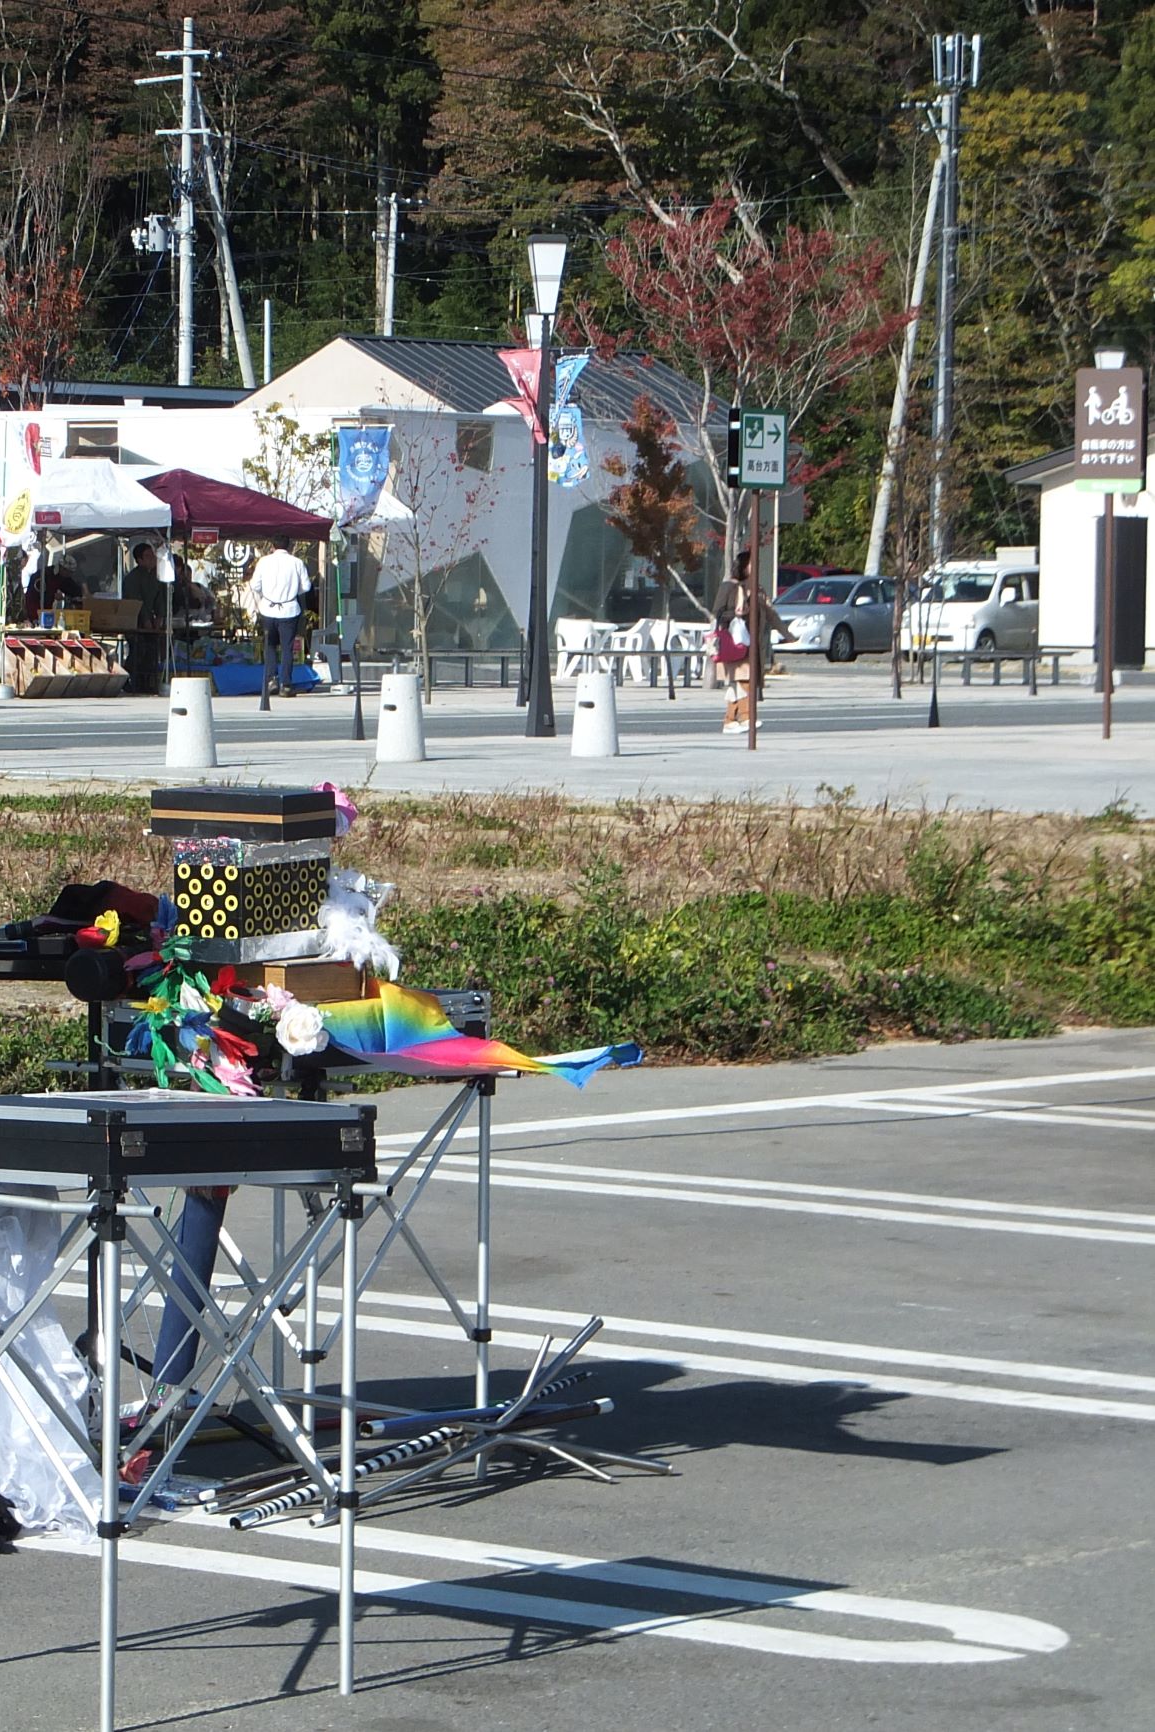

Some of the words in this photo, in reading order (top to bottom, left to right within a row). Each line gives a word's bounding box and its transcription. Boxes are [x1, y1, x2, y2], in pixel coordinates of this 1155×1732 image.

[1081, 453, 1135, 465] おりて下さい
[747, 460, 779, 472] 高台方面
